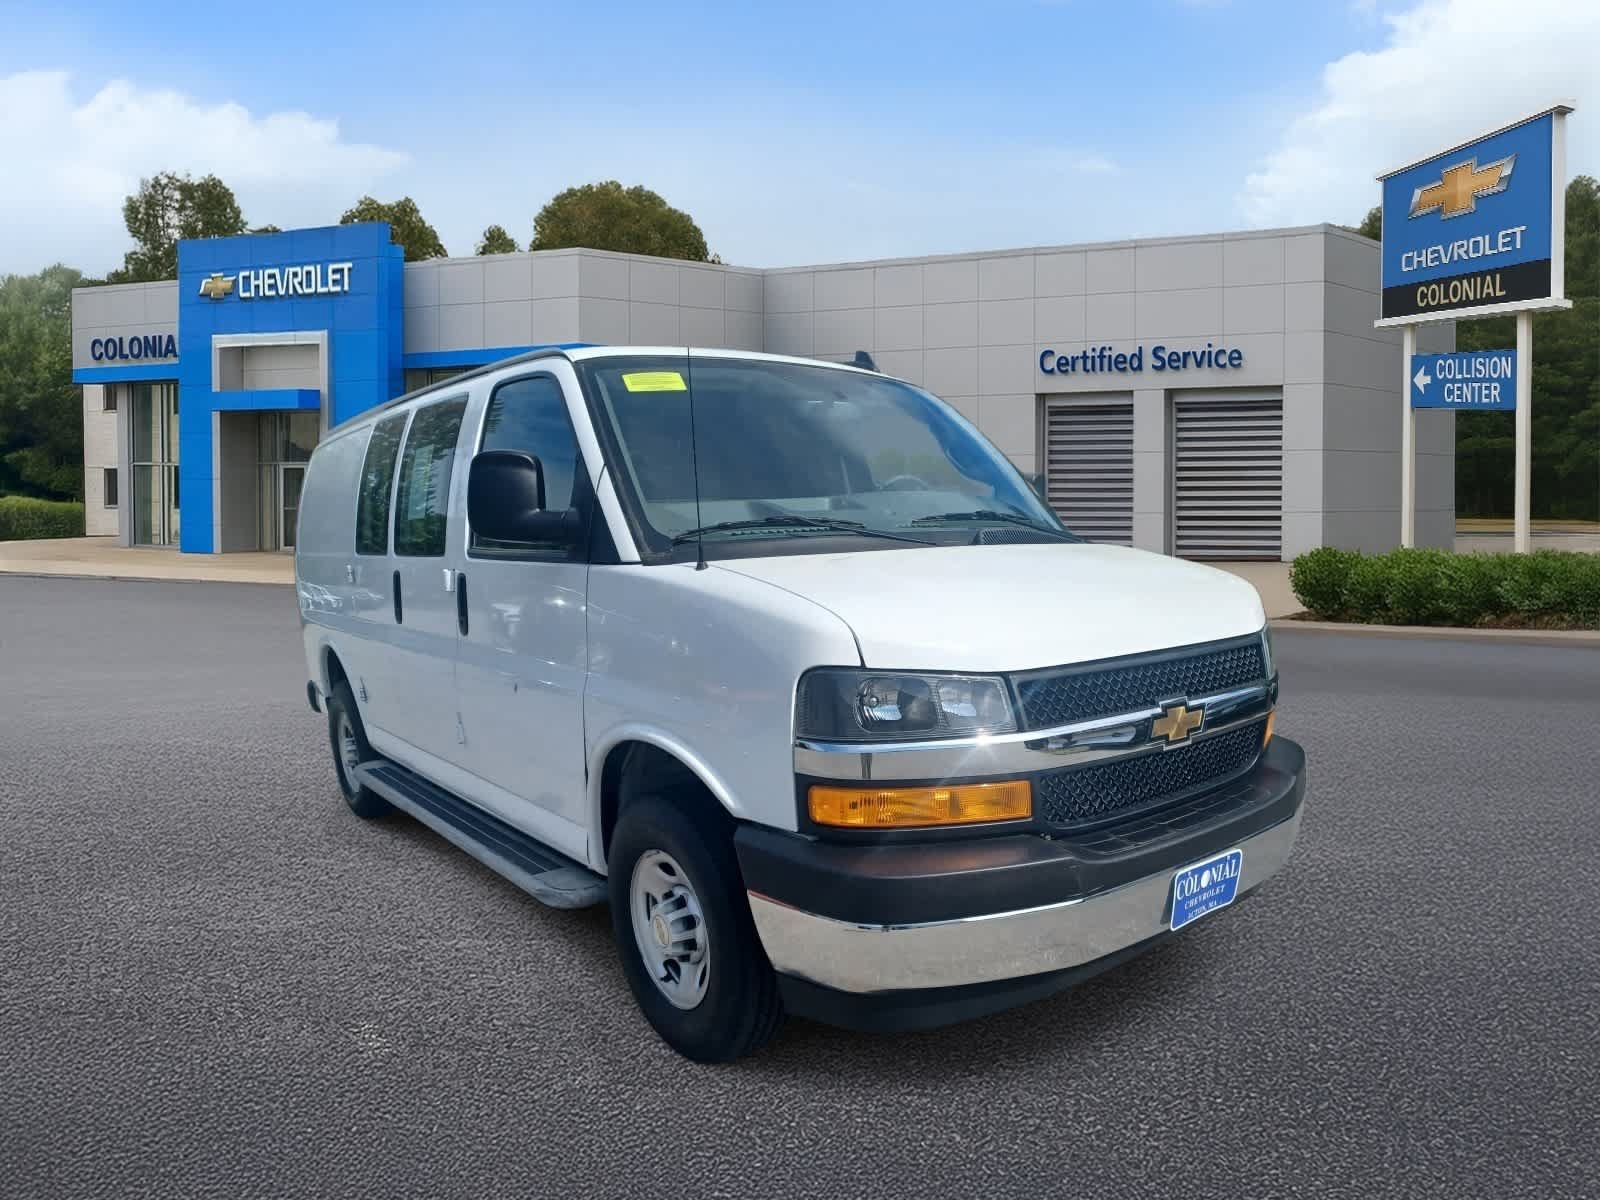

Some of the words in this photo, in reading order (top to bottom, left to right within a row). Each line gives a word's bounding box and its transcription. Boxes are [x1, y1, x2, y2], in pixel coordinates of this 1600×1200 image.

[1402, 225, 1527, 272] CHEVROLET
[239, 262, 353, 298] CHEVROLET
[1416, 274, 1506, 307] COLONIAL
[91, 334, 179, 361] COLONIA
[1039, 346, 1143, 375] Certified
[1151, 343, 1243, 372] Service
[1436, 356, 1512, 380] COLLISION
[1444, 382, 1501, 403] CENTER
[1176, 859, 1238, 900] COLONIAL
